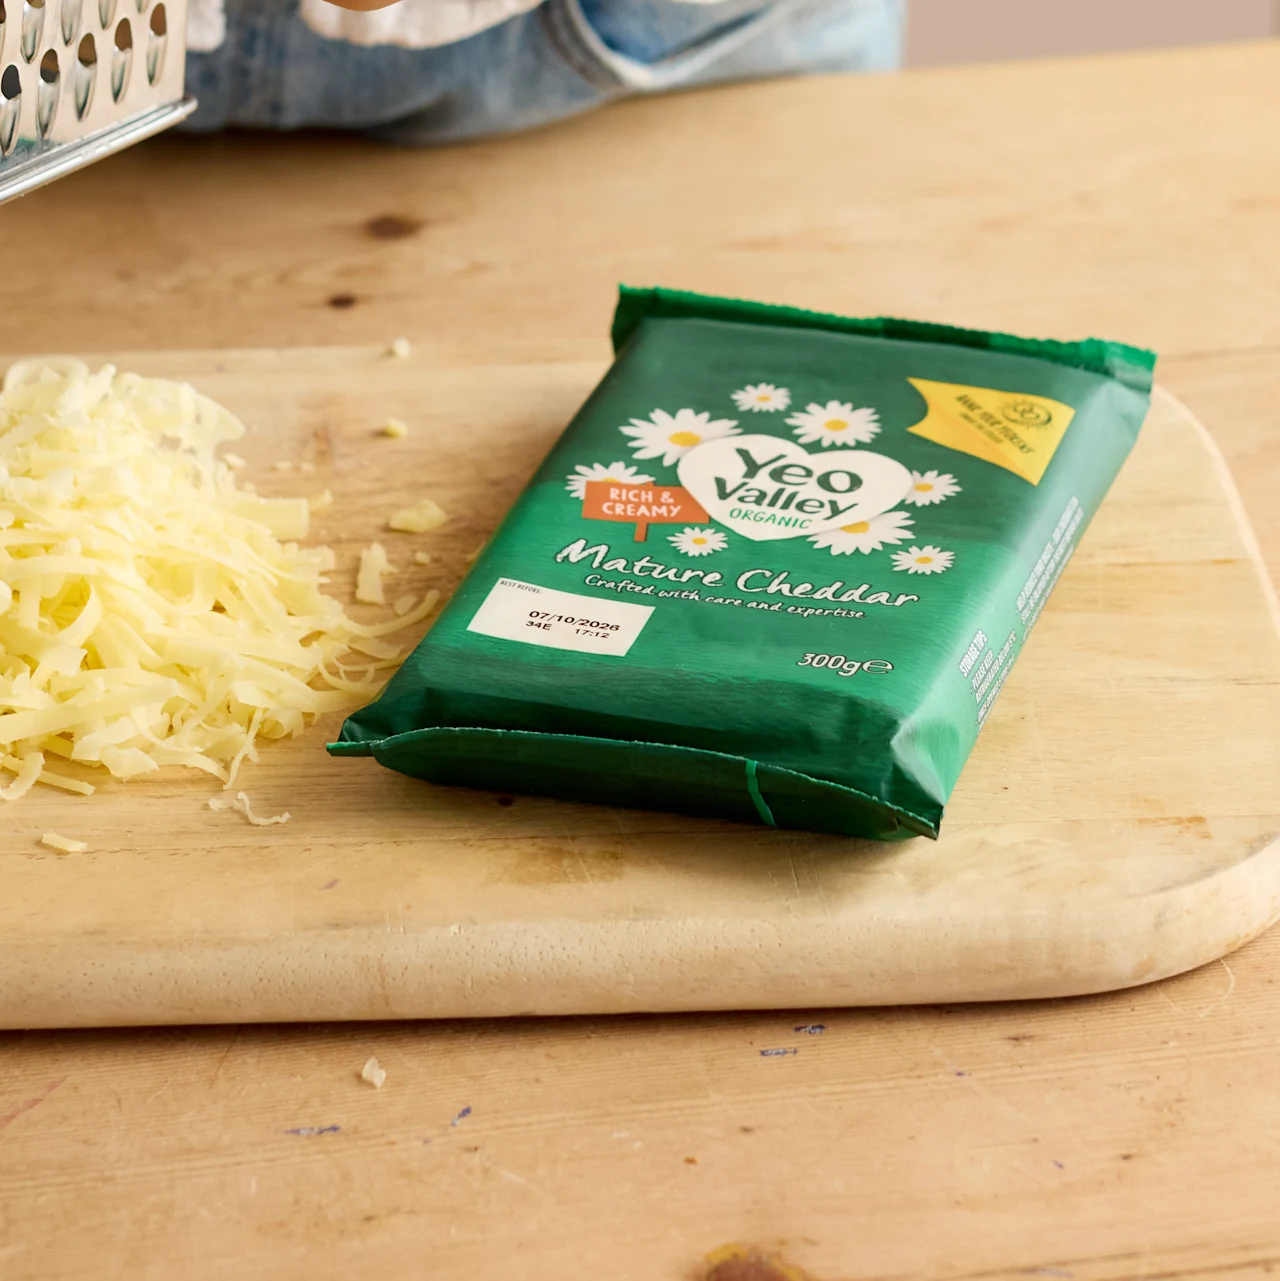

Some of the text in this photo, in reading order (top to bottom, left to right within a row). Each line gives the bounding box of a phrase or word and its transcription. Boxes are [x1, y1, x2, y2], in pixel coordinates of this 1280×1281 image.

[734, 447, 863, 493] Yeo
[609, 487, 674, 504] RICH &
[714, 476, 859, 521] Valley
[602, 501, 682, 517] CREAMY
[729, 507, 813, 529] ORGANIC
[500, 580, 516, 588] BEST
[554, 537, 920, 607] Mature Cheddar
[584, 573, 866, 619] Crafted with care and expertise
[525, 620, 610, 639] 34E 17:12
[528, 610, 621, 632] 07/10/2026
[959, 629, 988, 677] STORAGE TIPS
[972, 663, 987, 690] PLEASE
